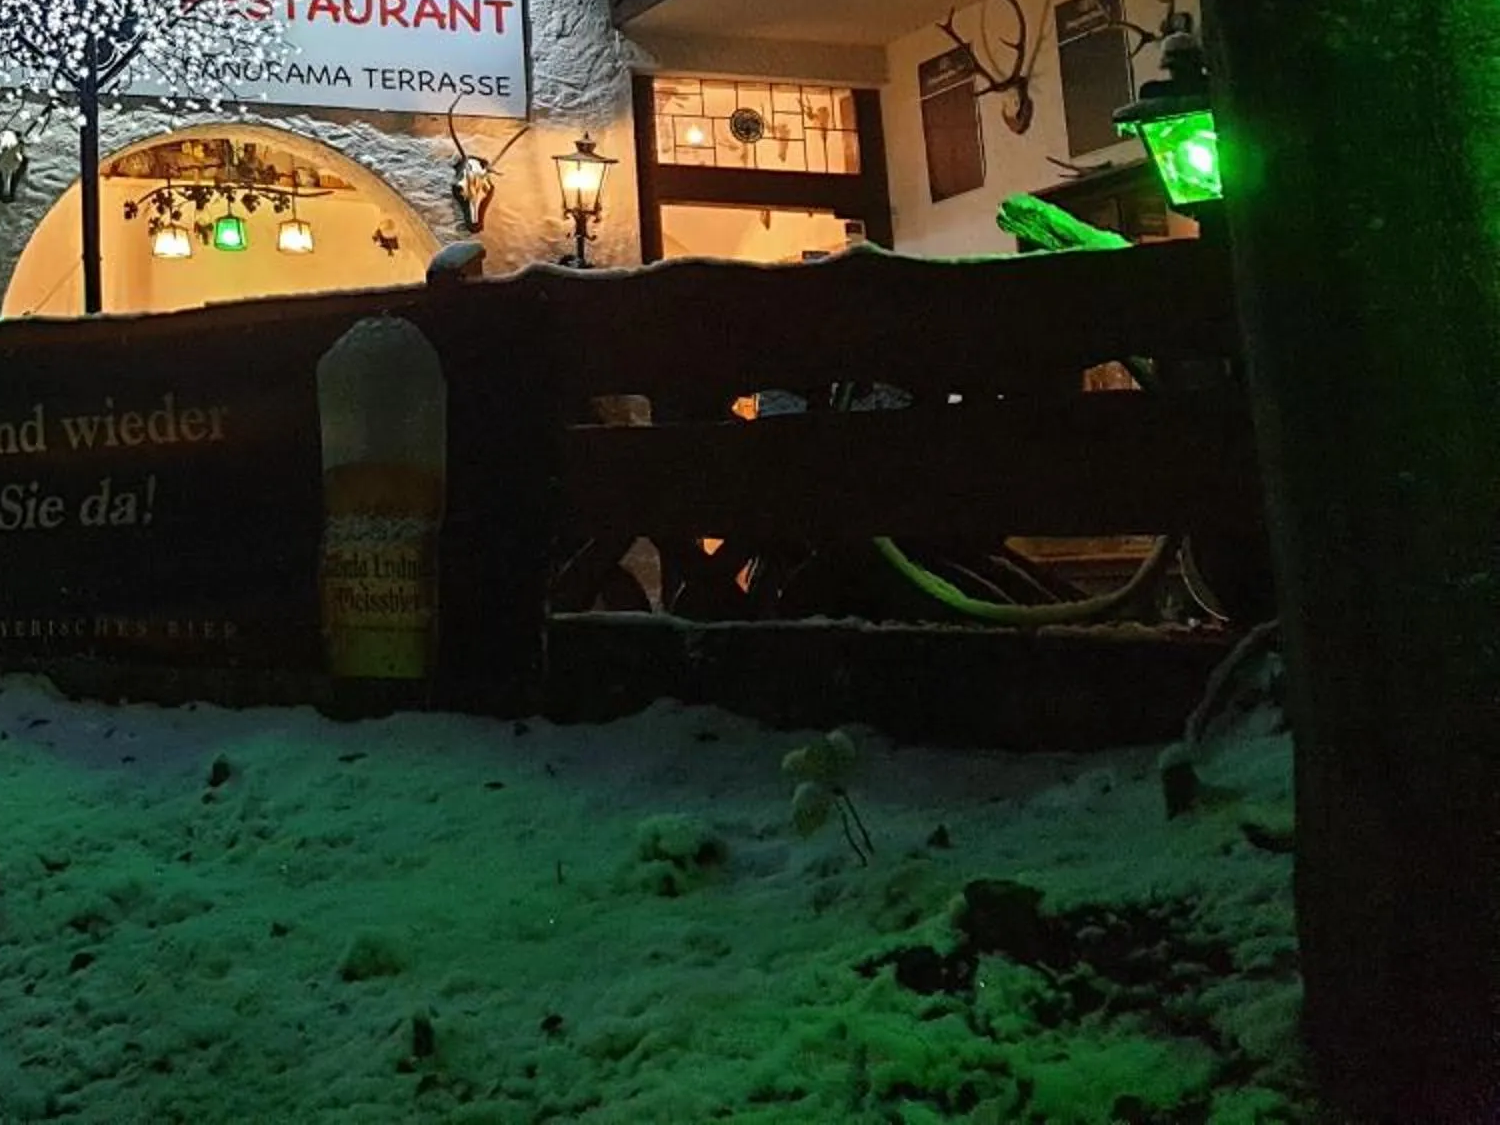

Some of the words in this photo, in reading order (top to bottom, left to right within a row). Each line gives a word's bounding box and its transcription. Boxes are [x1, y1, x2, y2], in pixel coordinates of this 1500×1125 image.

[362, 67, 511, 97] TERRASSE
[60, 392, 229, 450] wieder
[80, 474, 157, 527] da!
